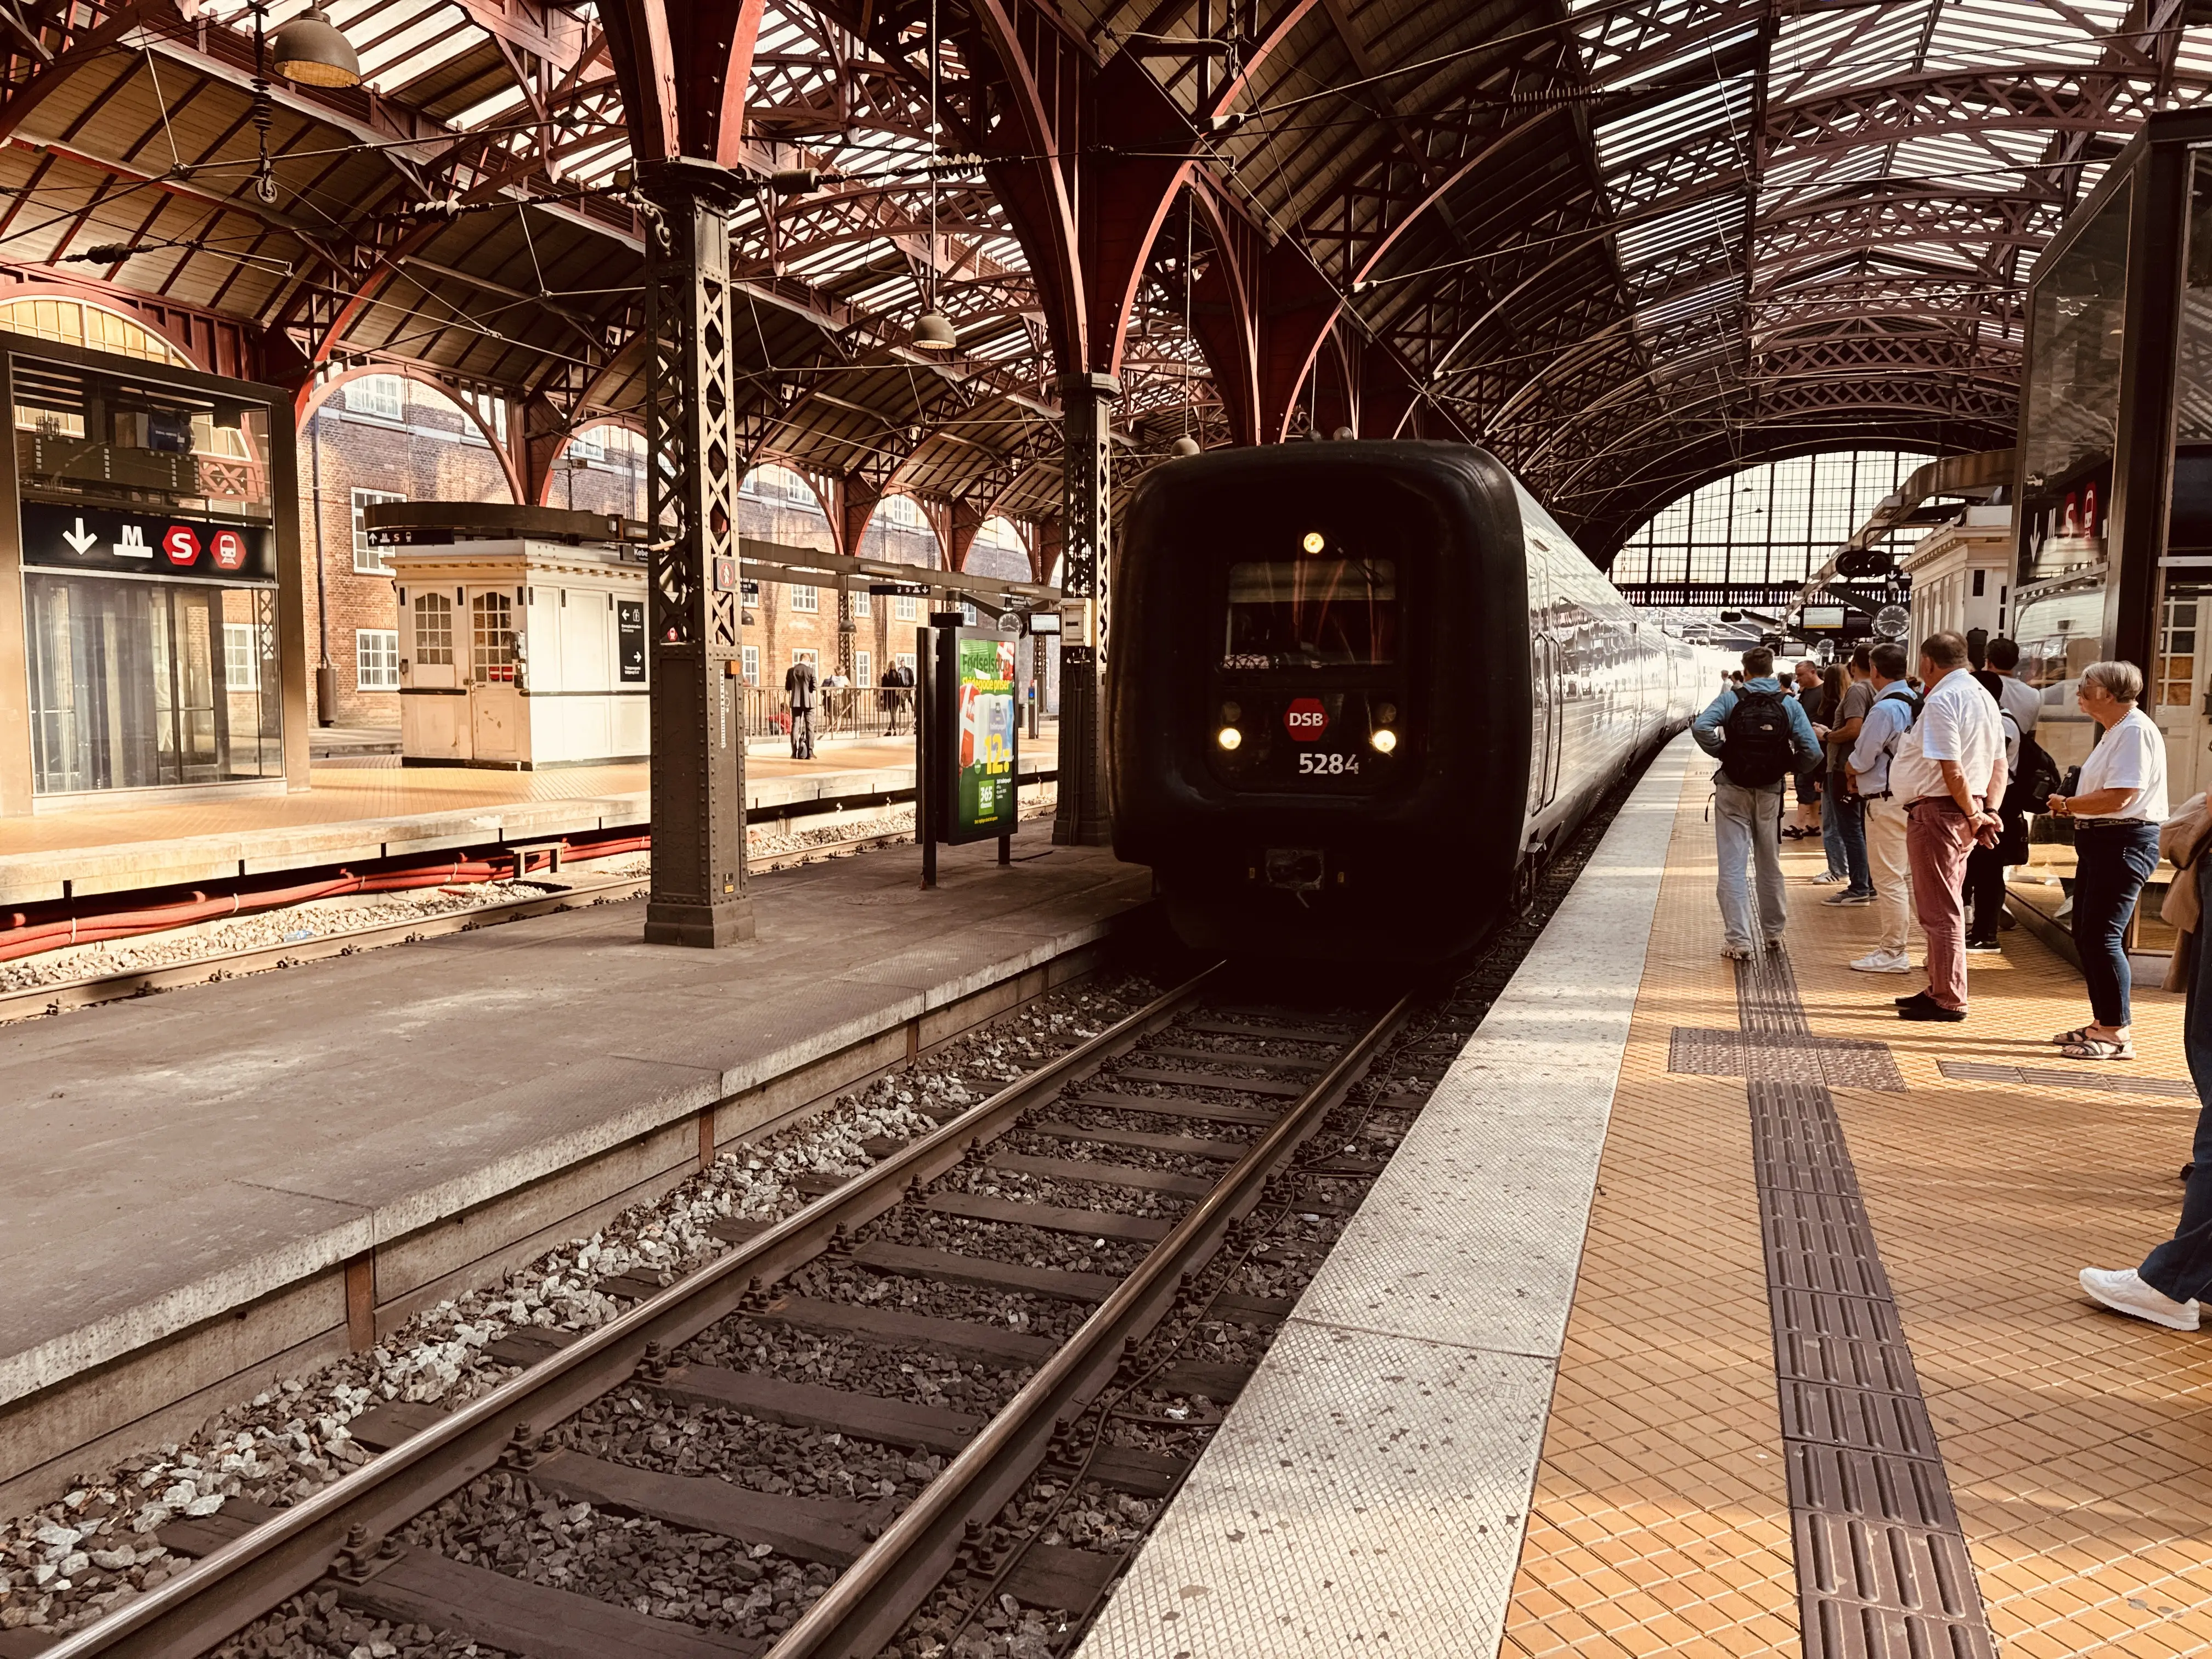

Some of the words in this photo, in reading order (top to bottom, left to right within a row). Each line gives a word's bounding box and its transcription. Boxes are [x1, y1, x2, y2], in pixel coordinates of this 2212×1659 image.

[2064, 503, 2074, 544] S
[172, 533, 193, 558] S
[393, 533, 400, 542] S
[994, 679, 1009, 693] priser
[1289, 713, 1323, 726] DSB
[1299, 753, 1359, 775] 5284
[980, 786, 993, 803] 365
